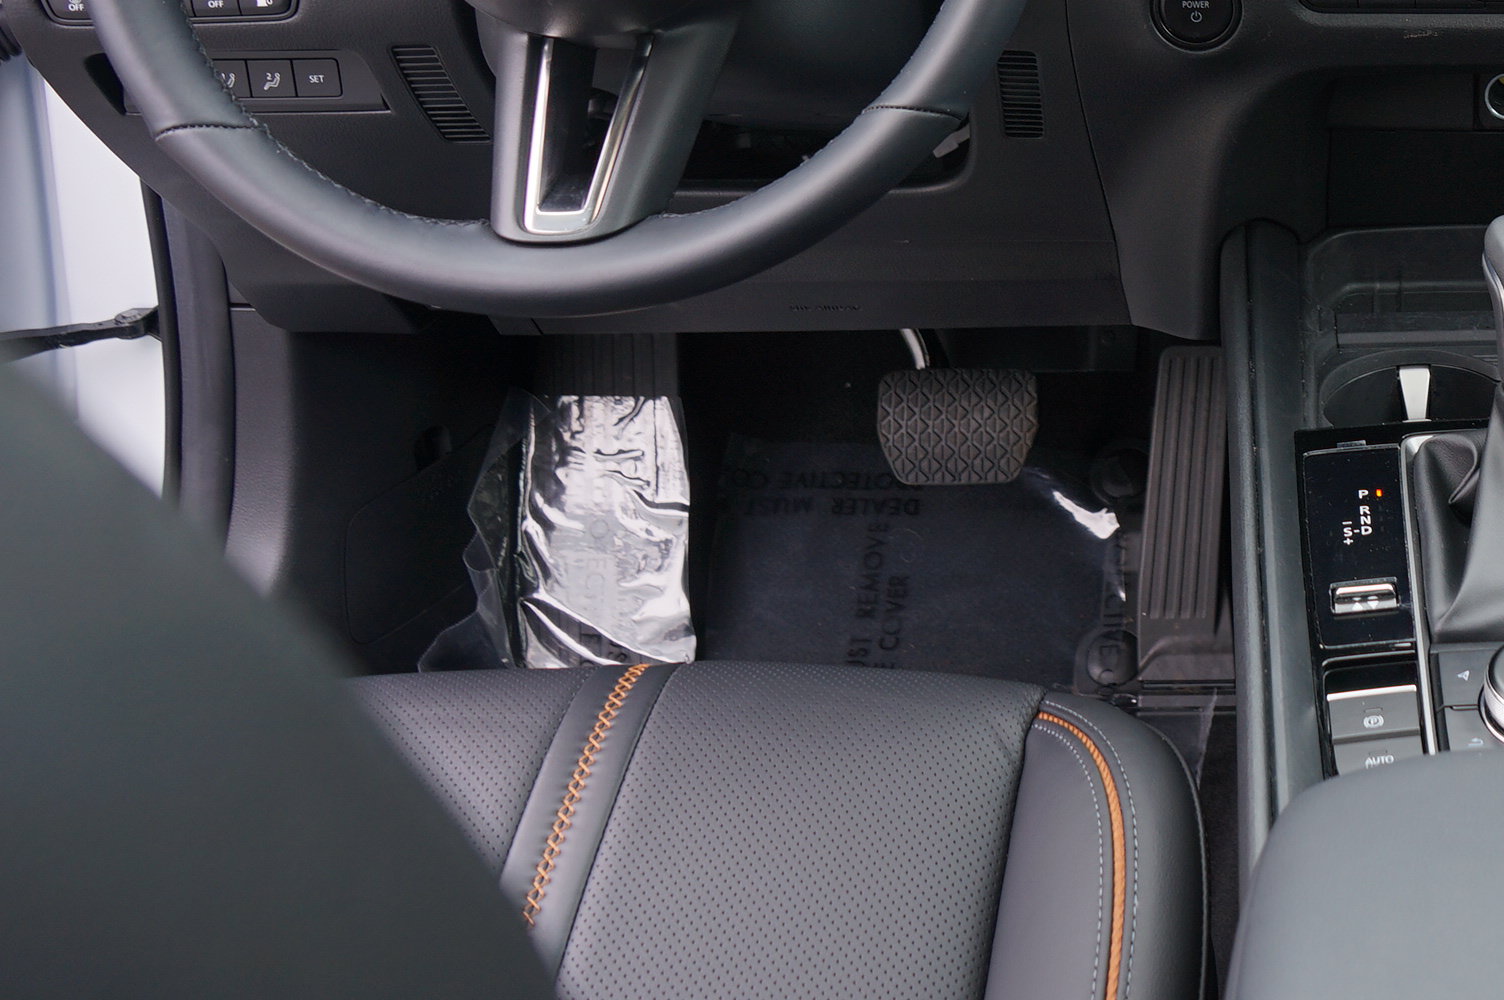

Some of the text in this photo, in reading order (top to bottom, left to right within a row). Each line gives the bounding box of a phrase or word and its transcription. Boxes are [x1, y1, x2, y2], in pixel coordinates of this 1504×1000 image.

[68, 3, 84, 11] OFF
[207, 0, 224, 8] OFF
[1182, 0, 1209, 9] POWER
[309, 75, 324, 84] SET
[1358, 489, 1369, 499] P
[1360, 505, 1371, 515] R
[1360, 515, 1371, 525] N
[854, 522, 889, 620] REMOVE
[1365, 754, 1395, 769] AUTO
